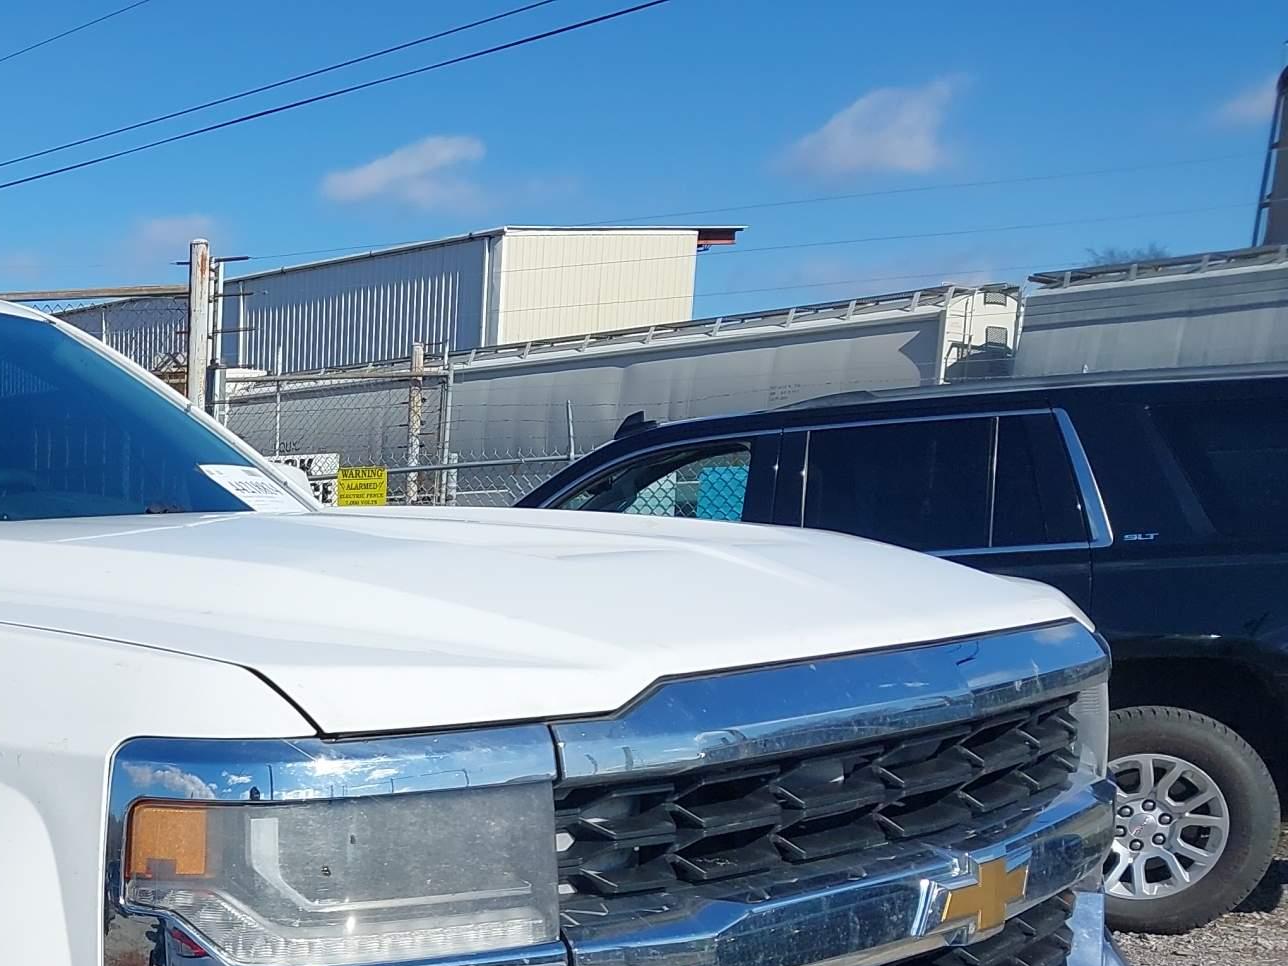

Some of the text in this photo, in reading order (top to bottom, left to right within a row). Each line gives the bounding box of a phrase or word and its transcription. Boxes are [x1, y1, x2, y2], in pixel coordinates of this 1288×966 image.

[341, 469, 383, 479] WARNING
[346, 482, 378, 490] ALARMED
[1123, 532, 1160, 541] SLT
